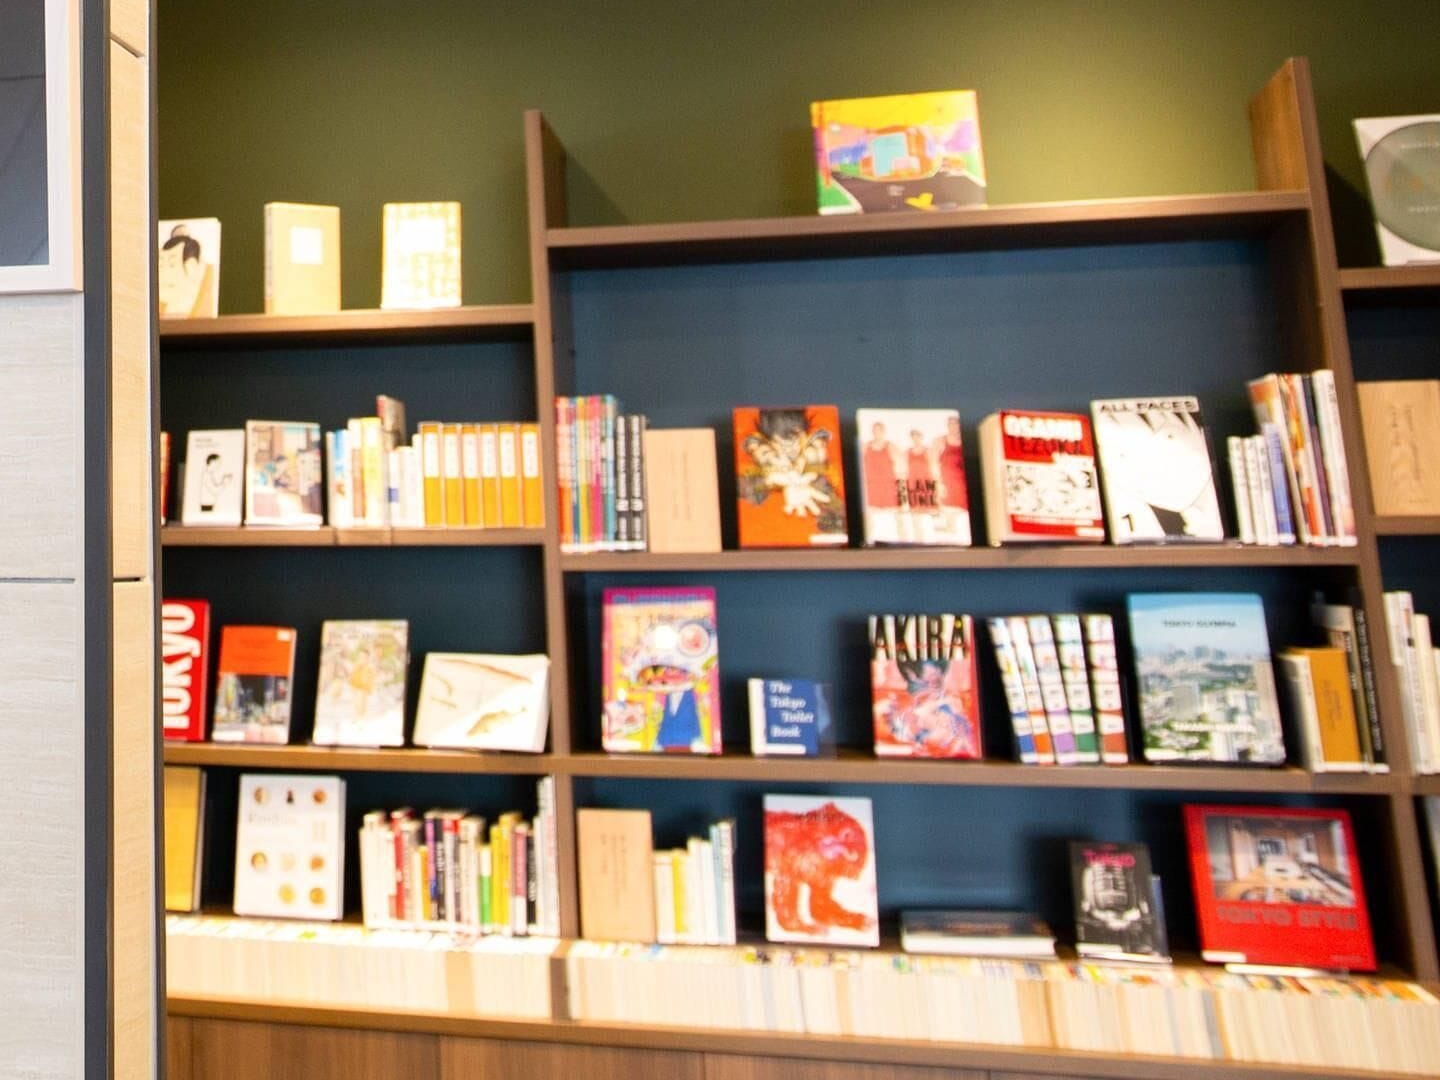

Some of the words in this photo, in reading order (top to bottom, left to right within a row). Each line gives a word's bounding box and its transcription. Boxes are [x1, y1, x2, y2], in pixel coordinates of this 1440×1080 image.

[873, 613, 970, 663] AKIRA
[769, 696, 807, 711] Tokyo
[770, 724, 801, 738] Book
